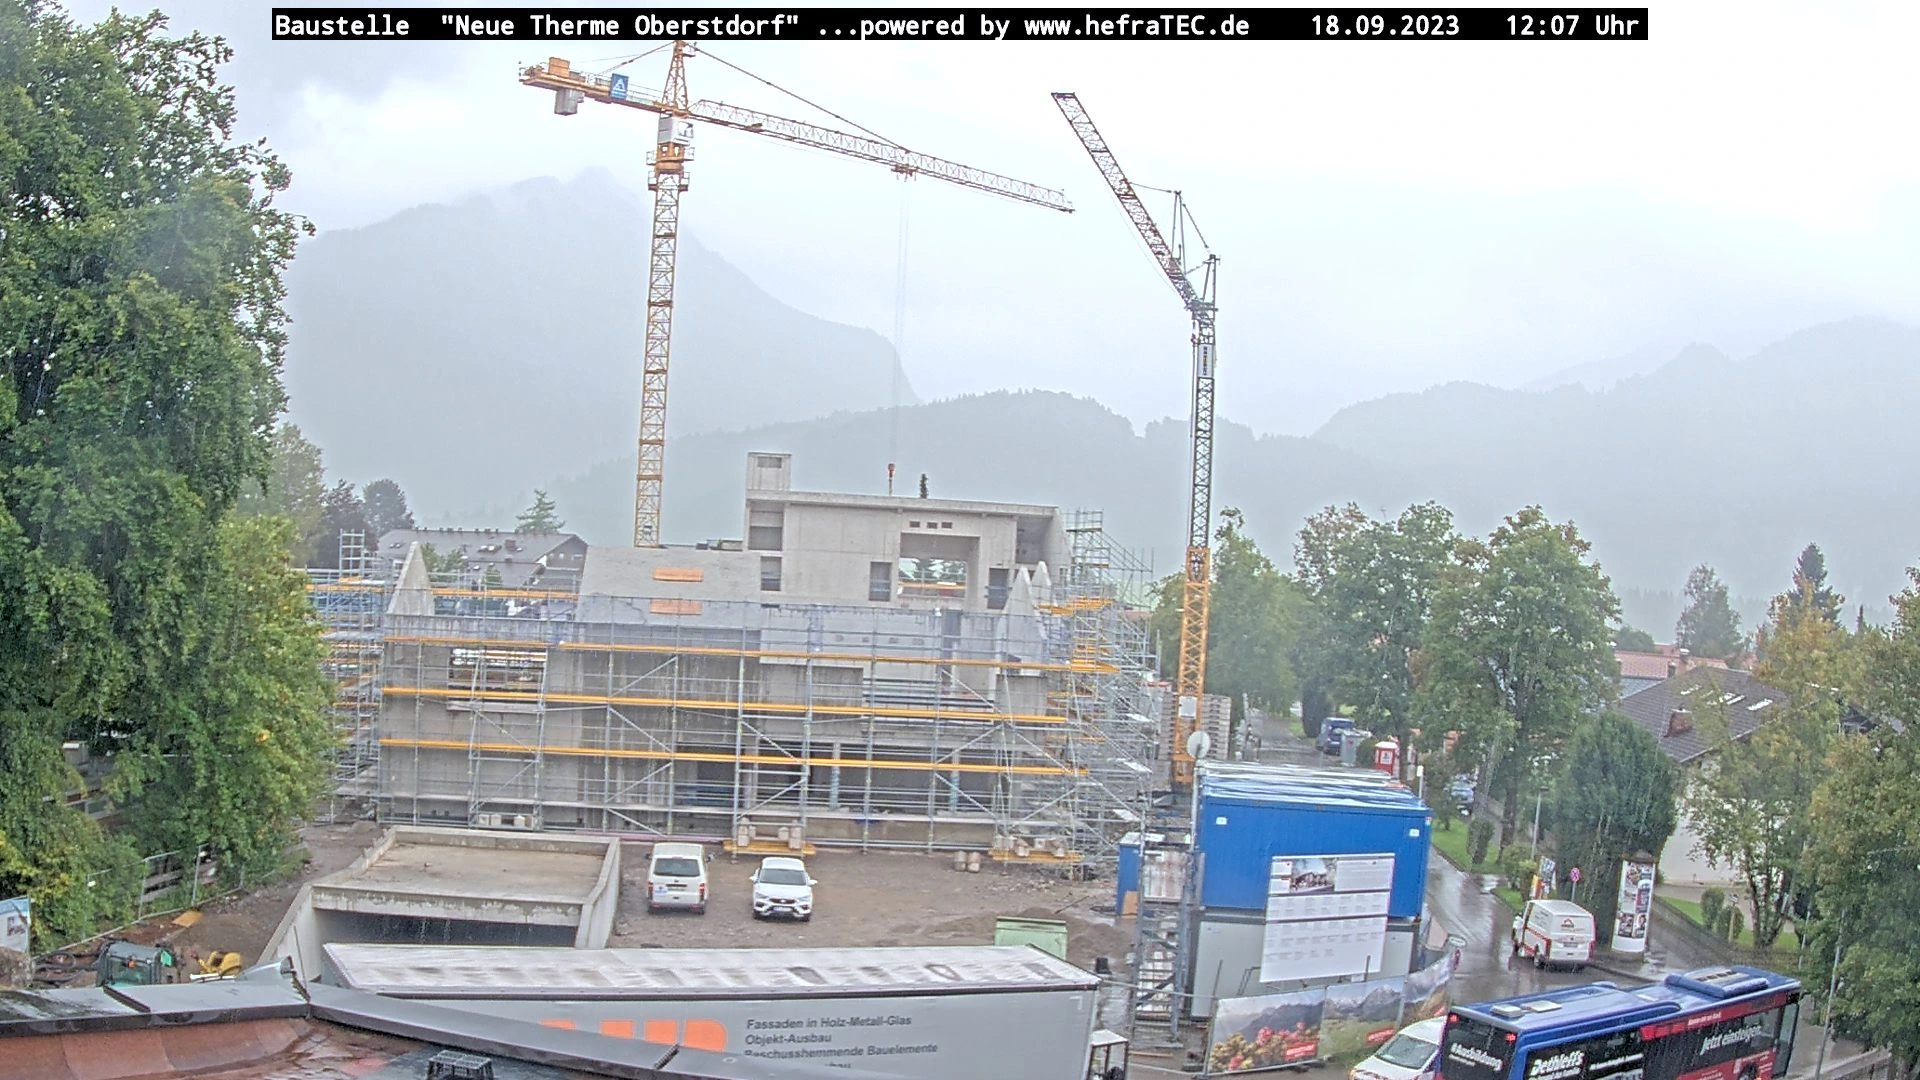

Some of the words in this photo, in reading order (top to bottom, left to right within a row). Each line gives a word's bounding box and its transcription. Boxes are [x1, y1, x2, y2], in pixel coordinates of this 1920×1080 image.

[746, 1019, 803, 1030] Fassaden
[806, 1018, 817, 1028] in
[821, 1015, 912, 1028] Holz-Metall-Glas
[745, 1034, 832, 1047] Objekt-Ausbau
[867, 1043, 939, 1056] Bauelemente
